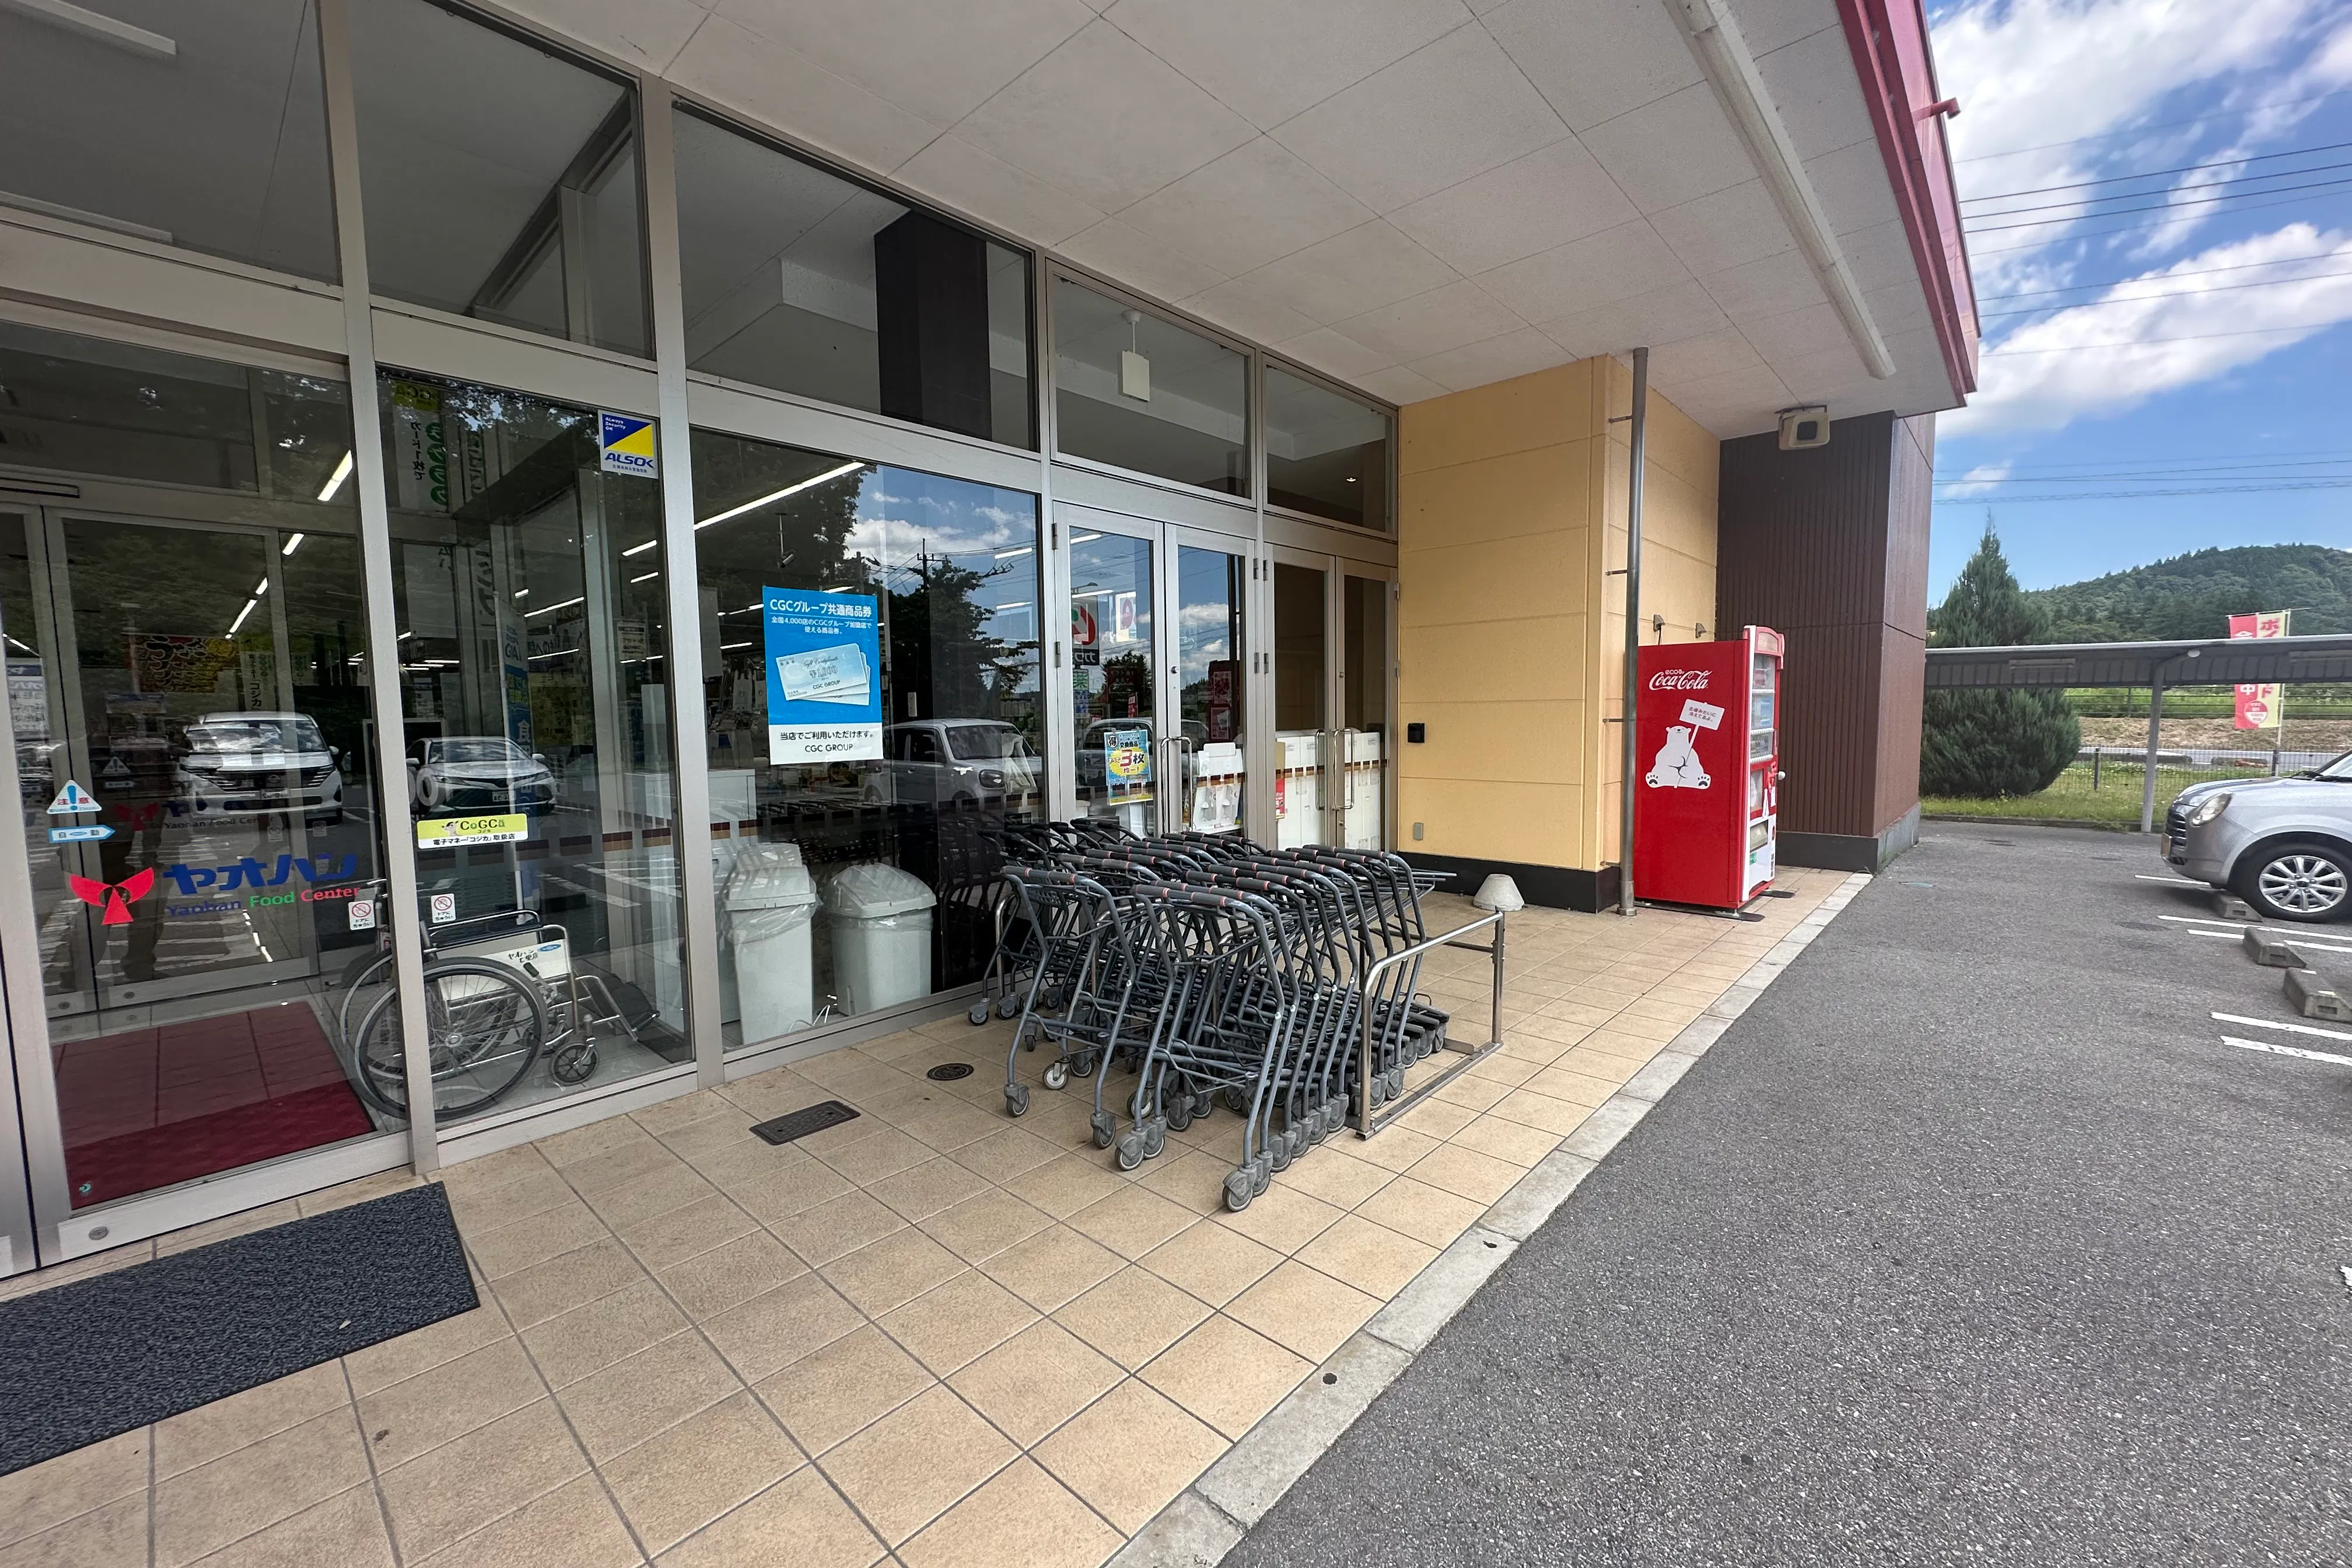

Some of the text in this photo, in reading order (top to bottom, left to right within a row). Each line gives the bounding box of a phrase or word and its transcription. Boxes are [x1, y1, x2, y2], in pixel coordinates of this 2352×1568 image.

[605, 452, 656, 470] ALSOK
[769, 598, 872, 618] CGCグループ共通商品券
[1648, 670, 1713, 691] Coca-Cola
[780, 730, 873, 741] 当店でご利用いただけます。
[804, 743, 853, 752] CGC GROUP
[57, 797, 90, 805] 注意
[460, 818, 506, 831] CoGCa
[163, 853, 357, 895] ヤオハン
[167, 887, 361, 917] Yaohan Food Center
